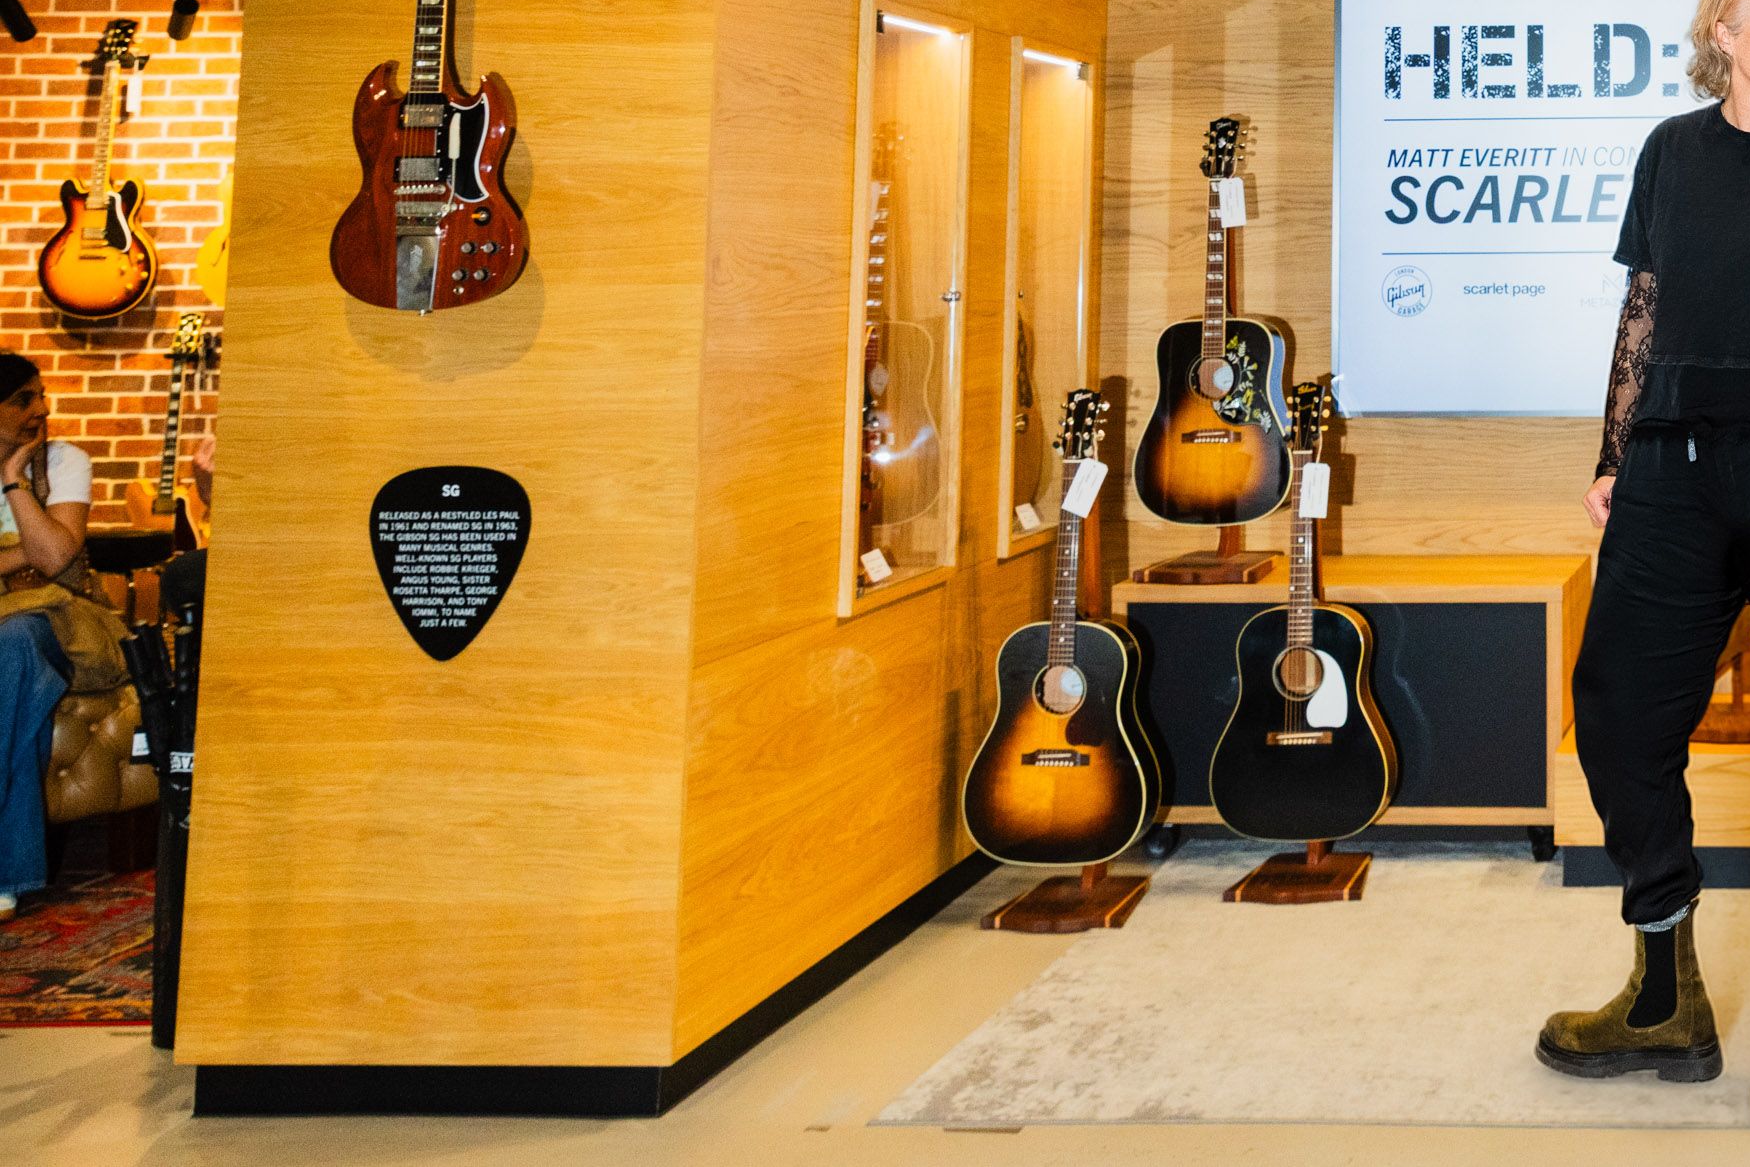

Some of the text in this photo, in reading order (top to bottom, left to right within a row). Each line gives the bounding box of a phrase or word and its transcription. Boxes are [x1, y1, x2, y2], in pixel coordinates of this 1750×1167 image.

[1384, 23, 1680, 99] HELD:
[1387, 148, 1454, 168] MATT
[1459, 147, 1557, 167] EVERITT
[1562, 146, 1587, 166] IN
[1384, 174, 1631, 225] SCARLE
[1387, 284, 1425, 308] Gibson
[1463, 282, 1546, 298] scarlet page
[441, 484, 460, 497] SG
